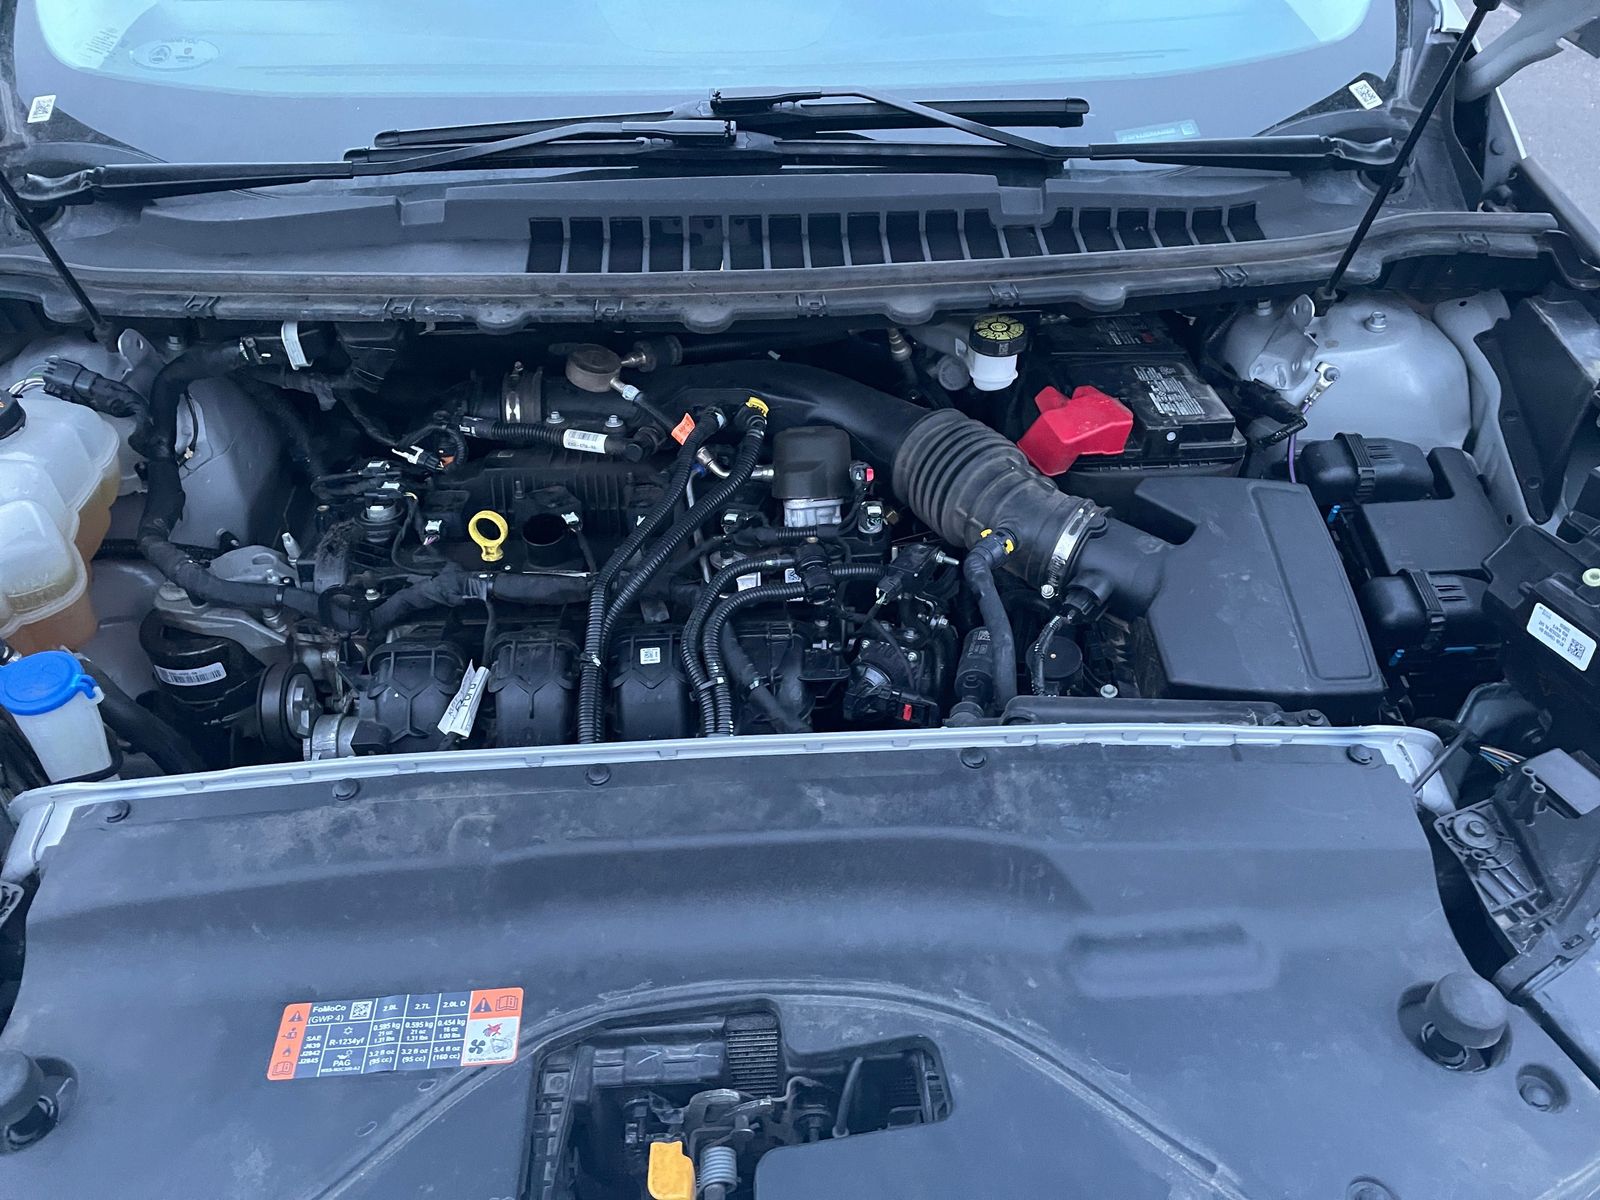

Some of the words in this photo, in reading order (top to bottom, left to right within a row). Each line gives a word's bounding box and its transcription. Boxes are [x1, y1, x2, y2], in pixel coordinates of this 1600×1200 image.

[312, 1004, 347, 1013] FoMoCo
[382, 1004, 399, 1012] 2.0L
[308, 1016, 333, 1024] (GWP
[437, 1019, 456, 1027] 0.454
[457, 1018, 466, 1027] kg
[373, 1023, 391, 1031] 0.595
[424, 1021, 434, 1029] kg
[329, 1037, 365, 1046] R-1234yf
[368, 1058, 380, 1066] (95
[432, 1054, 449, 1062] (160
[332, 1059, 351, 1067] PAG
